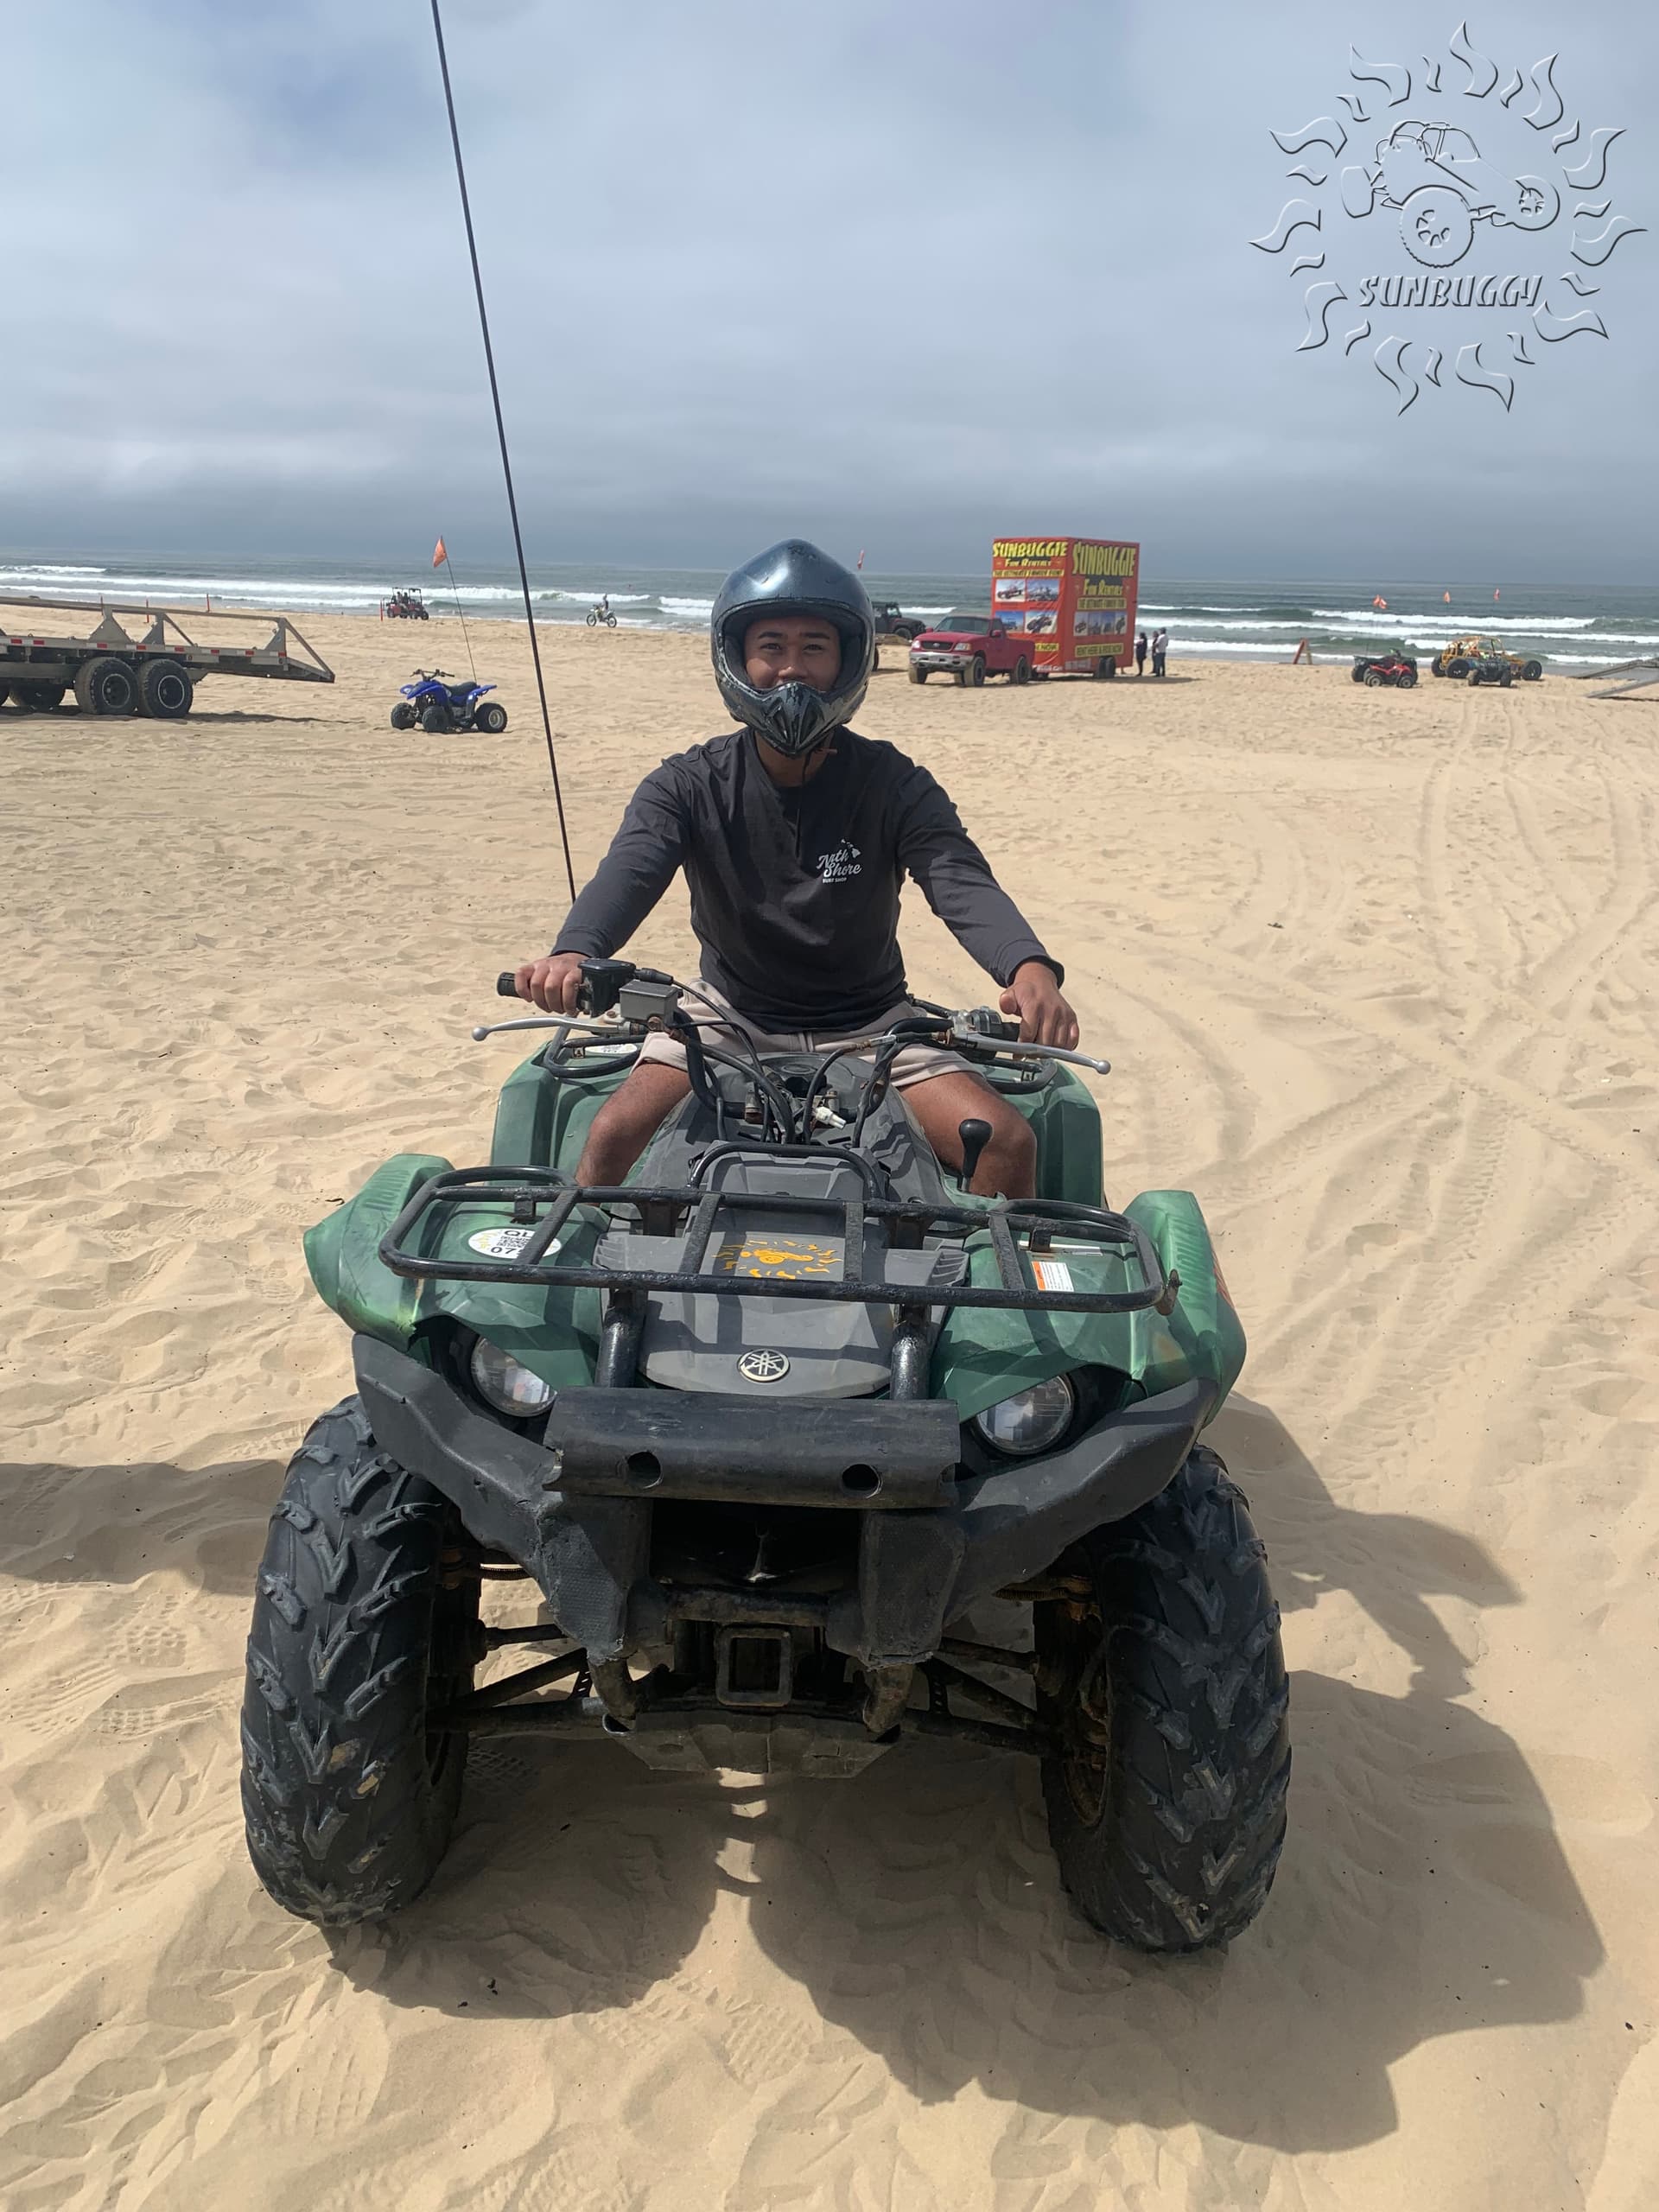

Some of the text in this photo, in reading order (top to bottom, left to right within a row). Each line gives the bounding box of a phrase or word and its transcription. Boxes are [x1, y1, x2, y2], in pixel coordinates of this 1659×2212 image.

[992, 541, 1069, 557] SUNBUGGIE
[1071, 541, 1136, 577] SUNBUGGIE
[823, 862, 862, 878] Shore
[490, 1246, 523, 1255] 07
